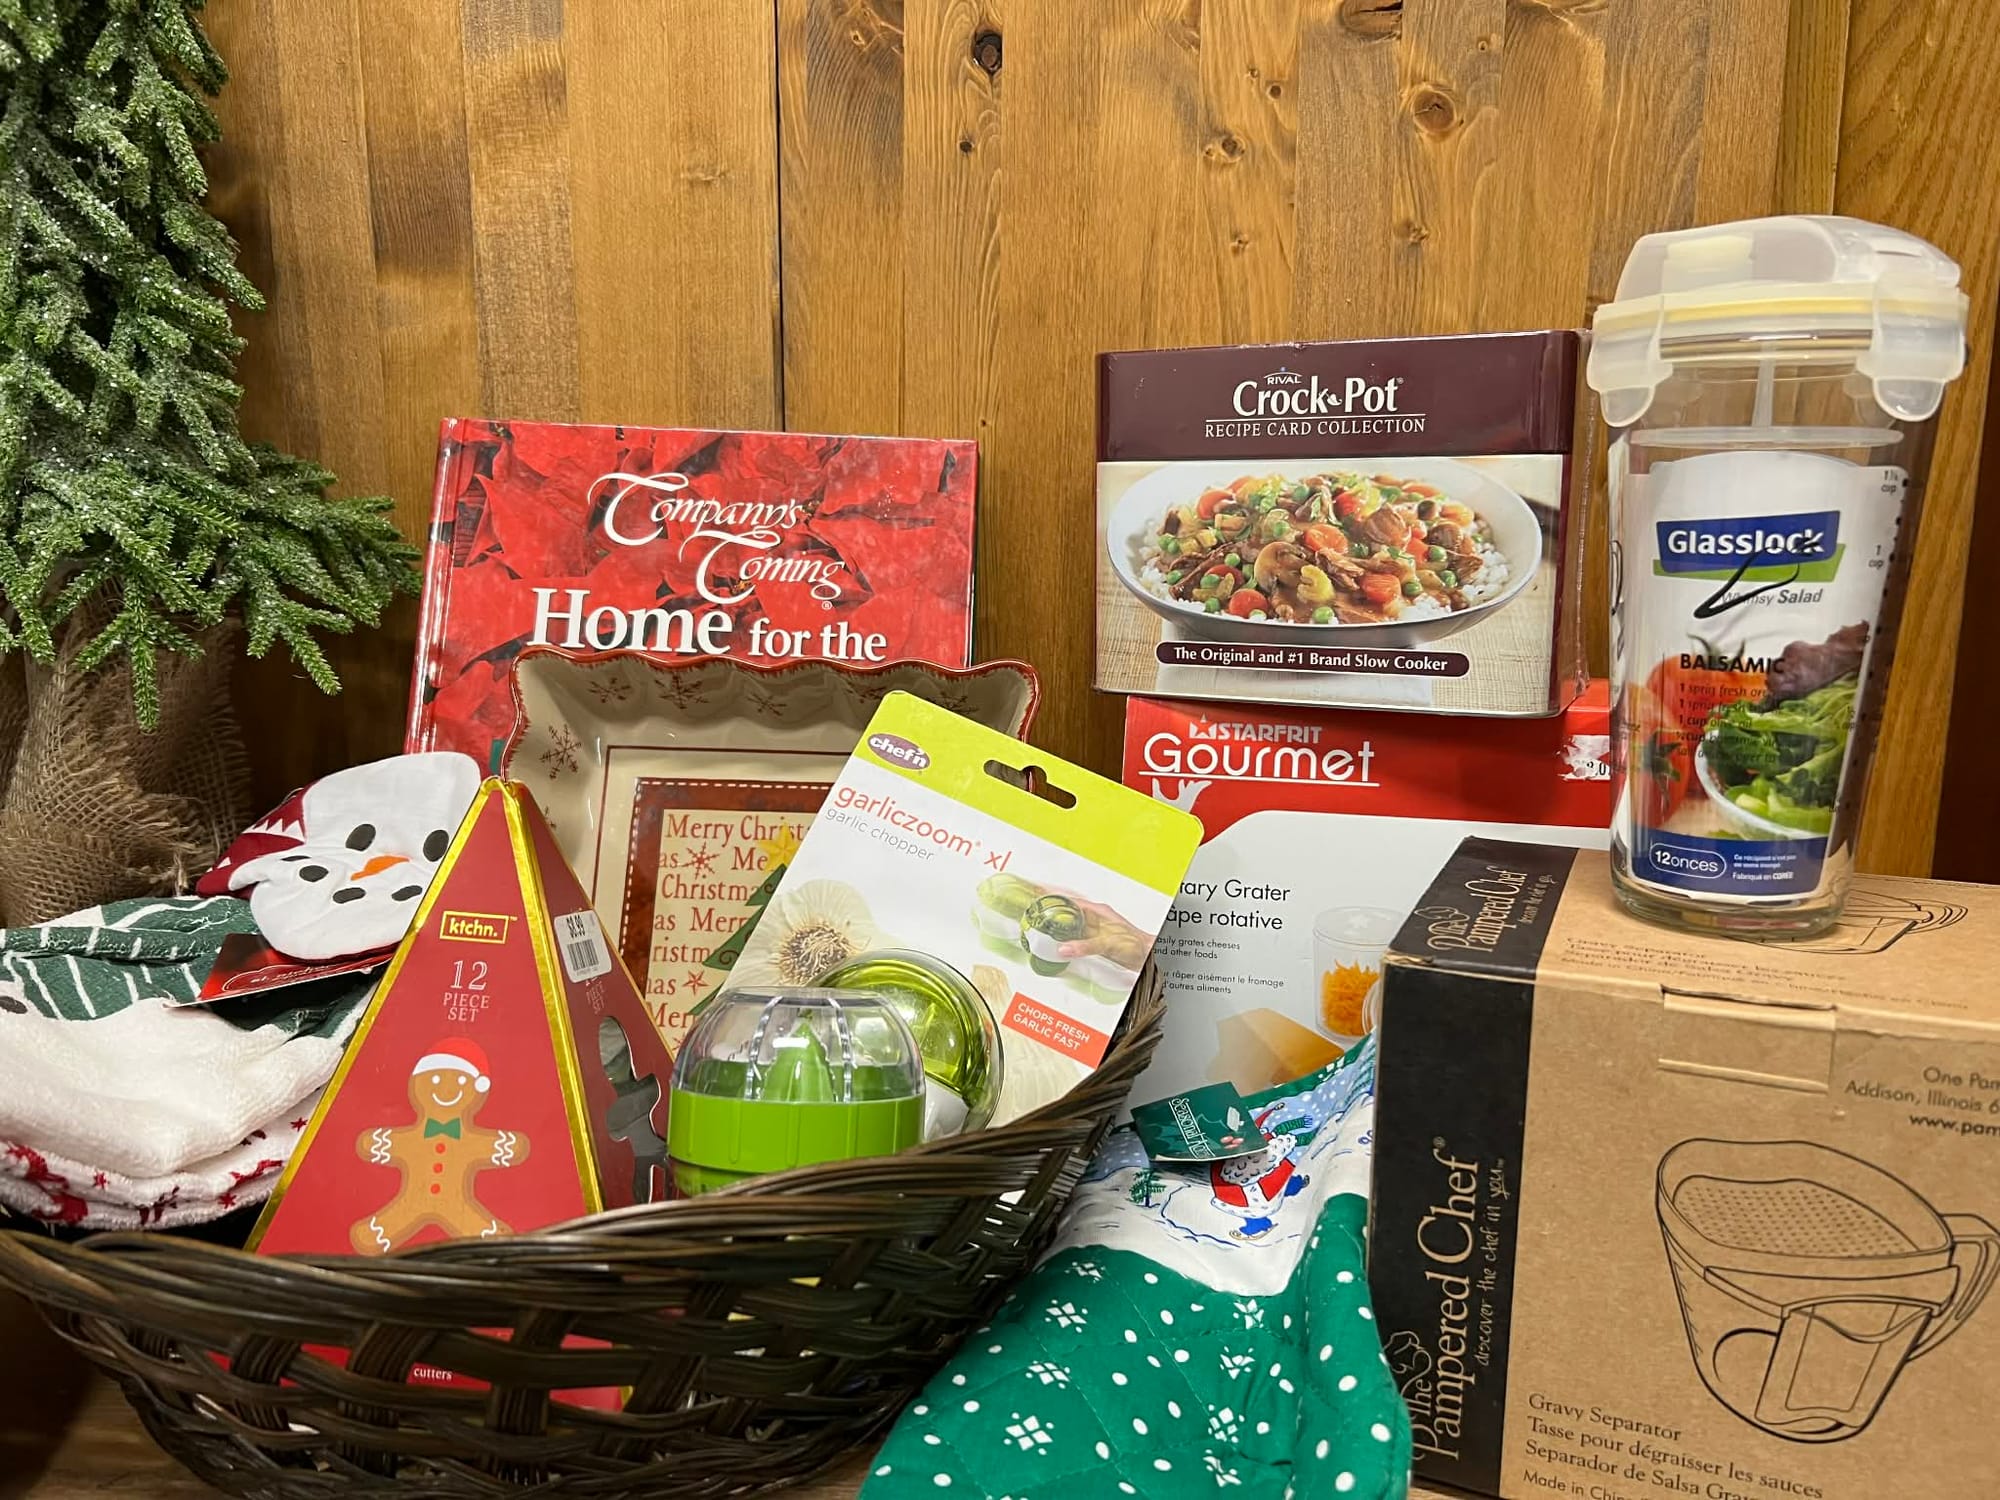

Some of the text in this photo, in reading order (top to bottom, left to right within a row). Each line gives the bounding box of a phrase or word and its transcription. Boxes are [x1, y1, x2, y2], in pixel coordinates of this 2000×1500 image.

[1266, 375, 1302, 385] RIVAL
[1205, 418, 1426, 438] RECIPE CARD COLLECTION
[587, 472, 803, 546] Company's
[1667, 528, 1825, 556] Glasslock
[679, 530, 844, 605] Coming
[1776, 589, 1824, 605] Salad
[527, 587, 888, 662] Home for the
[1173, 647, 1449, 672] The Original and #1 Brand Slow Cooker
[1679, 653, 1786, 675] BALSAMIC
[1679, 682, 1686, 693] 1
[1719, 683, 1749, 700] fresh
[1217, 723, 1323, 744] STARFRIT
[1686, 717, 1707, 729] cup
[869, 737, 927, 768] chef'n
[1143, 732, 1376, 783] Gourmet
[665, 814, 734, 848] Merry
[825, 807, 936, 862] garlic chopper
[983, 850, 1013, 873] xl
[1224, 879, 1291, 902] Grater
[1464, 866, 1529, 896] Chef
[654, 914, 676, 932] as
[1165, 904, 1284, 930] âpe rotative
[1427, 893, 1518, 953] Pampered
[1156, 936, 1241, 950] asily grates cheeses
[1170, 948, 1192, 957] other
[1194, 949, 1218, 959] foods
[449, 960, 489, 990] 12
[1248, 976, 1285, 989] fromage
[442, 992, 491, 1009] PIECE
[447, 1007, 479, 1023] SET
[1013, 1013, 1081, 1051] GARLIC FAST
[1018, 1002, 1091, 1043] CHOPS FRESH
[1923, 1066, 1962, 1087] One
[1844, 1079, 1922, 1106] Addison,
[1927, 1089, 1983, 1112] Illinois
[1416, 1147, 1480, 1265] Chef
[1488, 1204, 1502, 1222] in
[1482, 1222, 1503, 1262] chef
[1476, 1263, 1497, 1292] the
[1472, 1299, 1498, 1367] discover
[413, 1366, 453, 1381] cutters
[1411, 1269, 1476, 1461] Pampered
[1528, 1392, 1682, 1442] Gravy Separator
[1525, 1438, 1619, 1475] Separador
[1622, 1463, 1647, 1482] de
[1650, 1469, 1700, 1496] Salsa
[1526, 1415, 1824, 1500] Tasse pour dégraisser les sauces
[1522, 1468, 1567, 1492] Made
[1570, 1481, 1585, 1497] in
